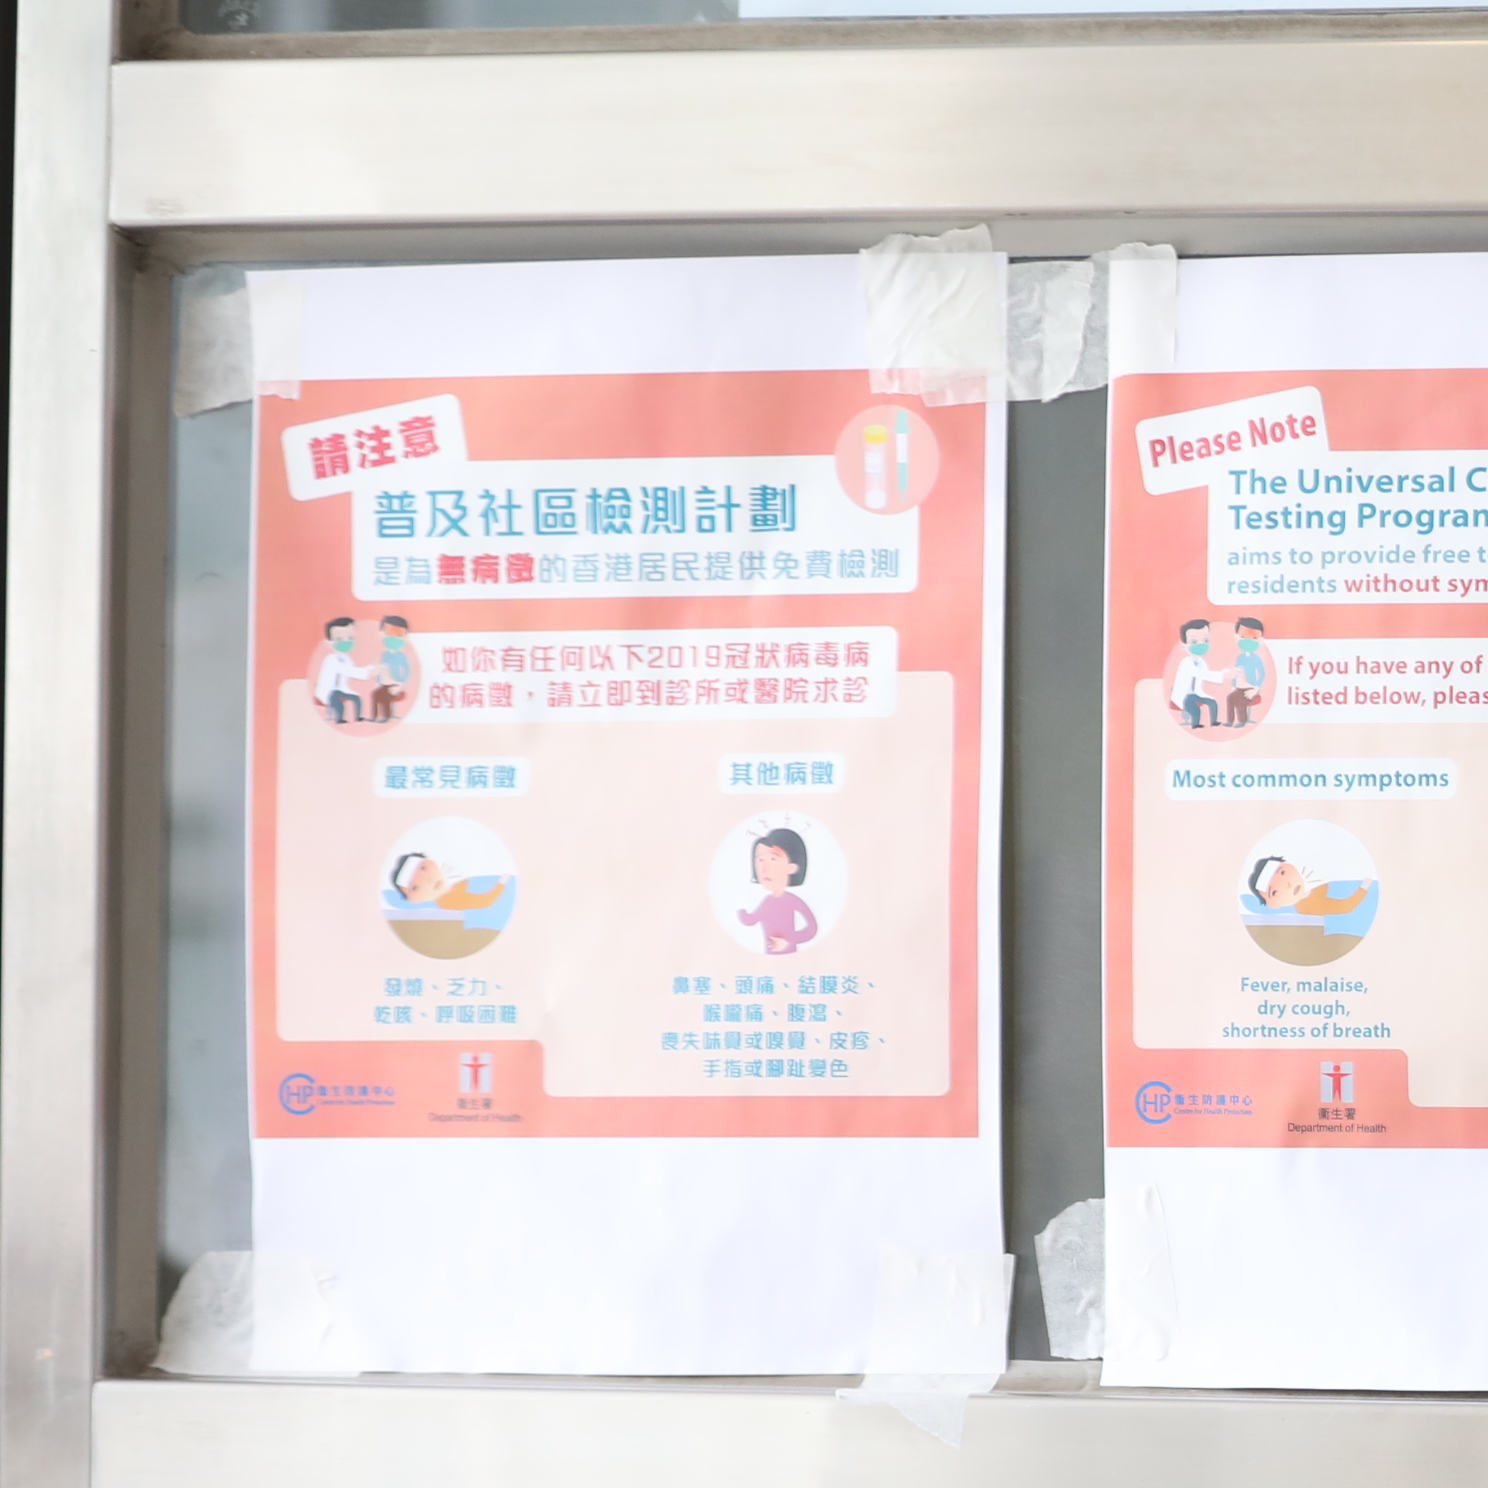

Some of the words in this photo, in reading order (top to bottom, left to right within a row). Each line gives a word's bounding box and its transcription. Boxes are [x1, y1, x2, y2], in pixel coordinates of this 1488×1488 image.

[308, 415, 440, 480] 請注意
[1149, 430, 1241, 468] Please
[1248, 413, 1316, 448] Note
[1229, 468, 1287, 495] The
[1296, 466, 1455, 495] Universal
[374, 483, 796, 539] 普及社區檢測計劃
[1228, 503, 1346, 536] Testing
[1228, 547, 1282, 566] aims
[1289, 548, 1313, 565] to
[1321, 544, 1416, 569] provide
[1423, 543, 1470, 564] free
[1228, 574, 1337, 594] residents
[1344, 572, 1440, 593] without
[442, 640, 869, 674] 如你有任何以下2019冠狀病毒病
[1289, 655, 1303, 675] If
[1309, 661, 1348, 680] you
[1356, 656, 1407, 675] have
[1414, 660, 1454, 680] any
[1460, 654, 1483, 674] of
[1288, 686, 1347, 706] listed
[1355, 686, 1426, 707] below,
[385, 764, 517, 790] 最常見病徵
[730, 760, 834, 787] 其他病徵
[1173, 769, 1226, 788] Most
[1232, 773, 1327, 788] common
[1334, 770, 1449, 792] symptoms
[1241, 976, 1290, 993] Fever,
[1297, 976, 1368, 994] malaise,
[1258, 999, 1286, 1019] dry
[1292, 999, 1350, 1019] cough,
[1223, 1022, 1305, 1038] shortness
[1310, 1022, 1329, 1038] of
[1333, 1022, 1391, 1038] breath
[1287, 1123, 1342, 1134] Department
[1345, 1123, 1354, 1133] of
[1357, 1124, 1387, 1134] Health
